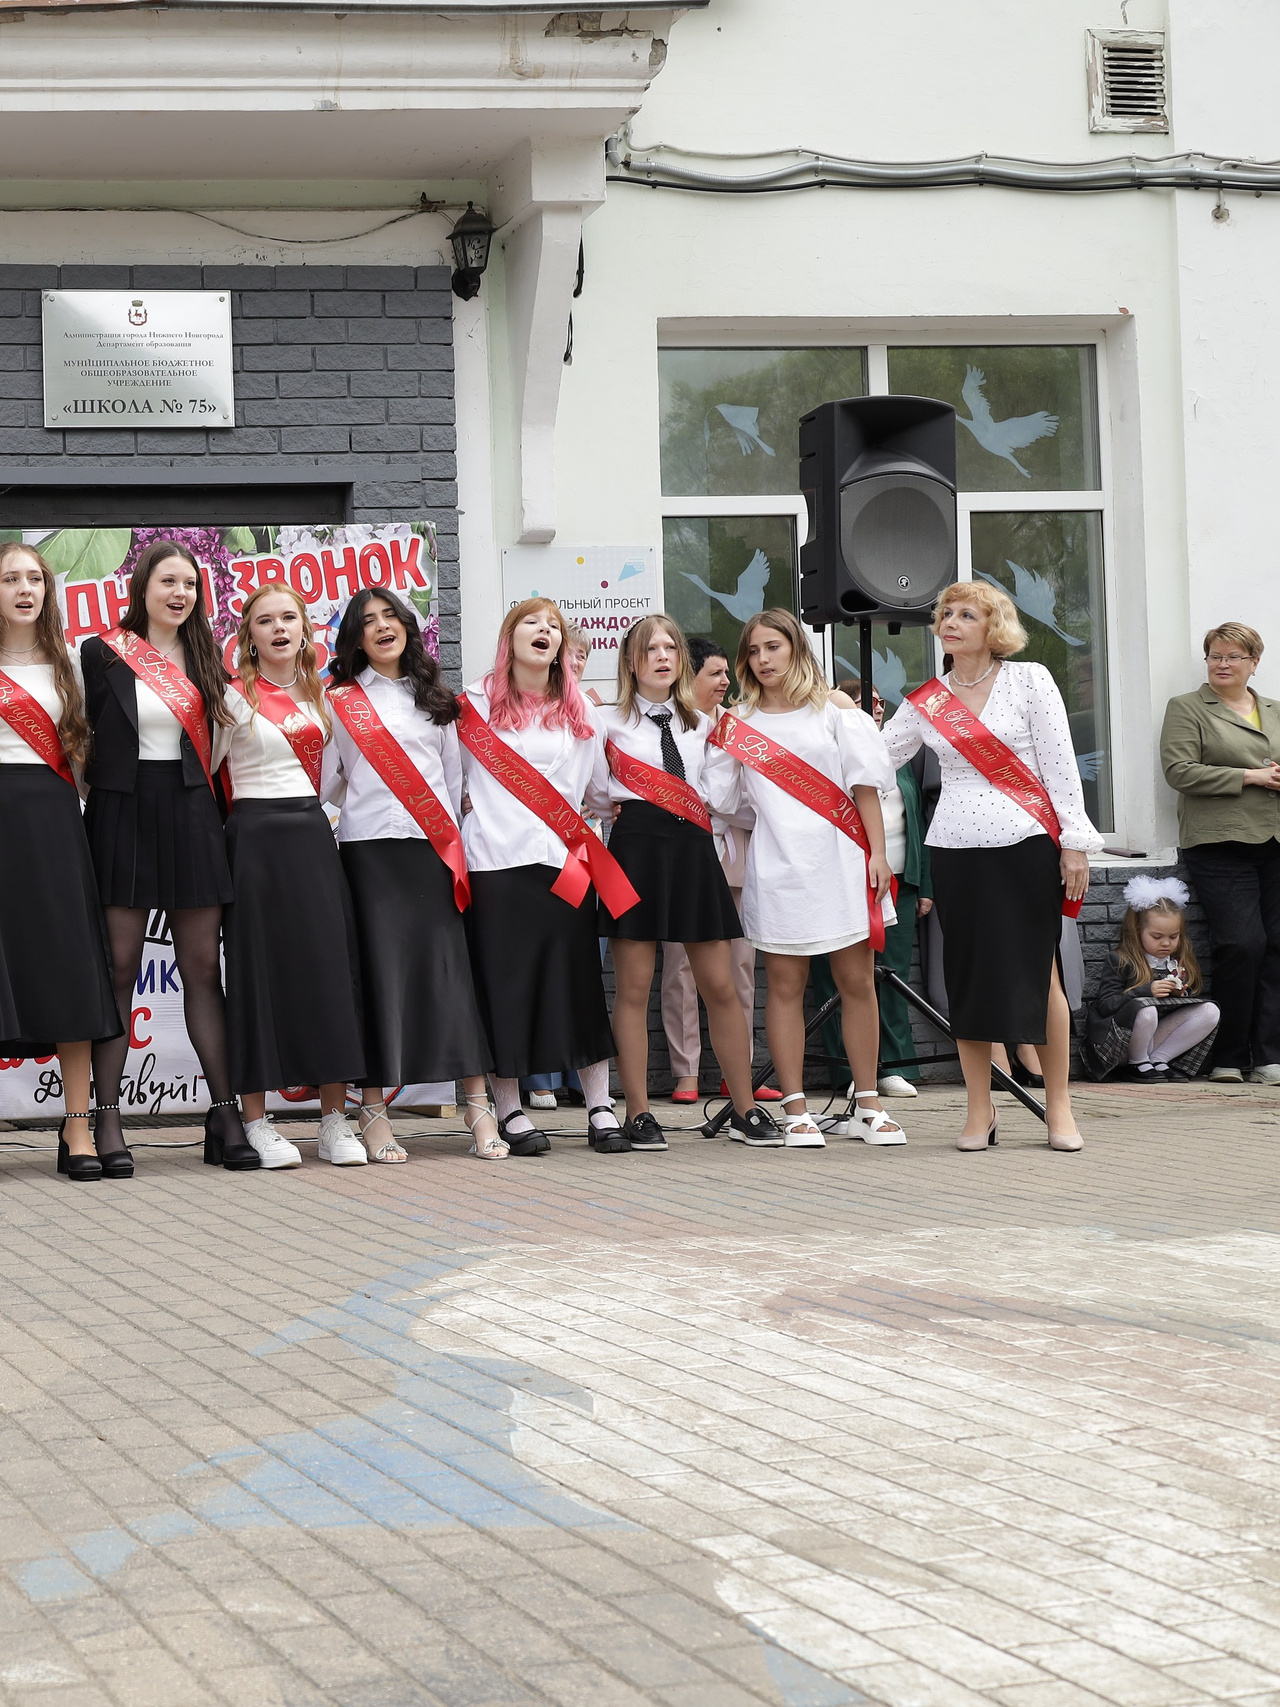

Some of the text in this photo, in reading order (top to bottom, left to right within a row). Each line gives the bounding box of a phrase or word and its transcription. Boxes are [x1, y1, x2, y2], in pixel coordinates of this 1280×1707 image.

[63, 331, 224, 341] Администрация города Нижнего Новгорода
[96, 340, 192, 349] Департамент образования
[152, 359, 214, 369] БЮДЖЕТНОЕ
[80, 369, 198, 378] ОБЩЕОБРАЗОВАТЕЛЬНОЕ
[107, 379, 172, 387] УЧРЕЖДЕНИЕ
[63, 398, 217, 414] «ШКОЛА № 75»
[509, 597, 651, 610] ФАЛЬНЫЙ ПРОЕКТ
[943, 708, 999, 764] Классный
[345, 700, 412, 789] Выпускница
[406, 787, 452, 837] 2025
[470, 726, 549, 806] Выпускница
[737, 735, 831, 806] Выпускница
[830, 797, 865, 839] 202
